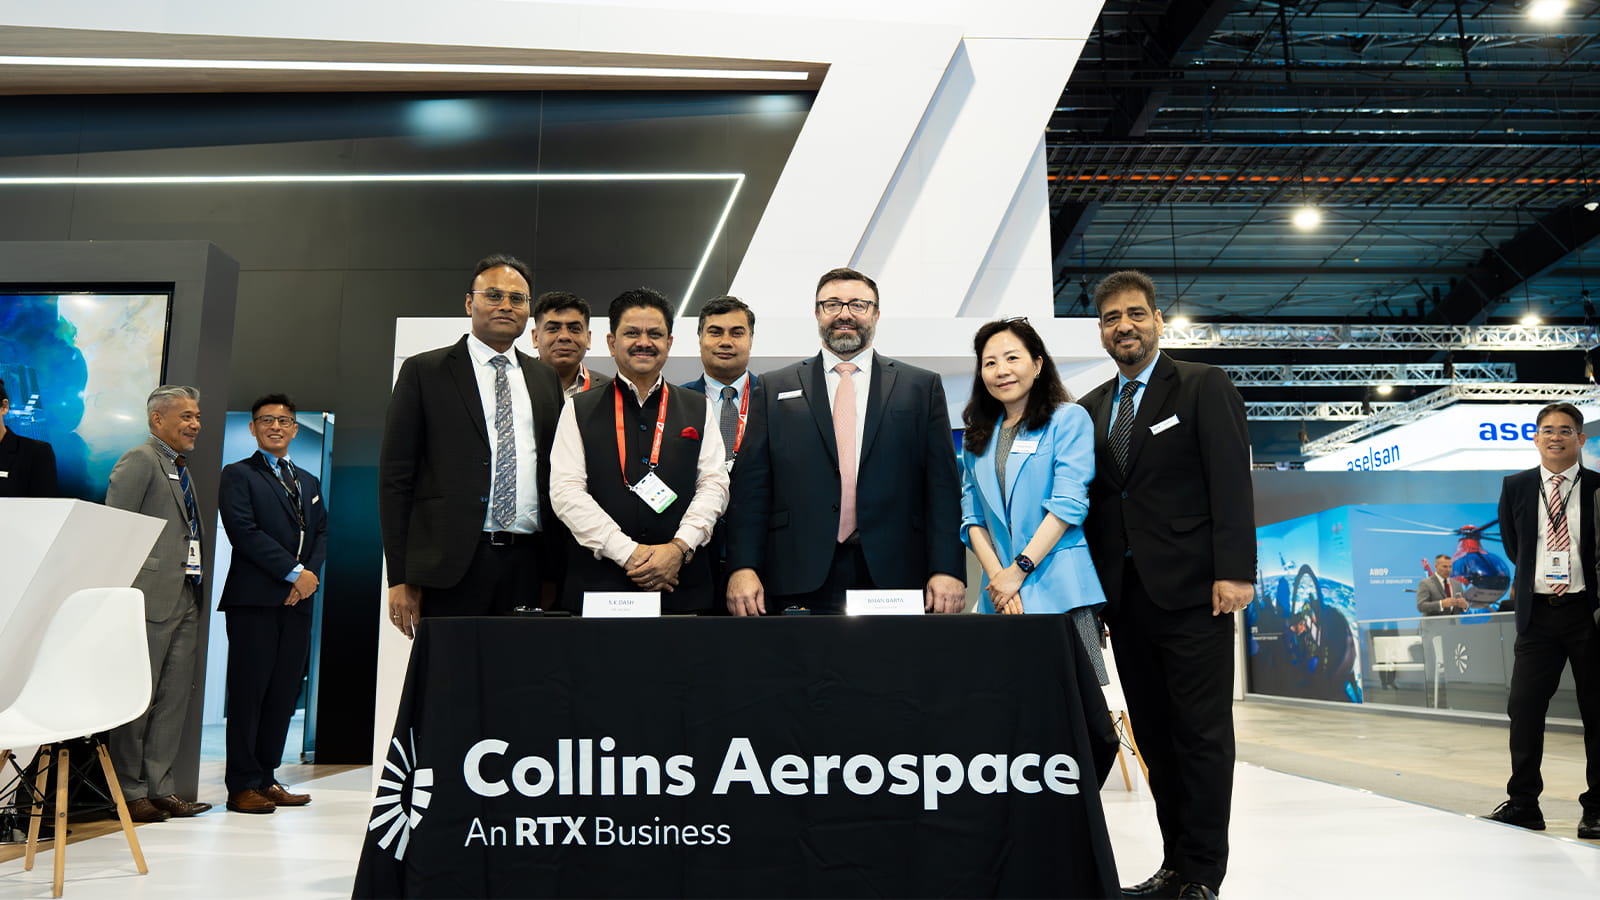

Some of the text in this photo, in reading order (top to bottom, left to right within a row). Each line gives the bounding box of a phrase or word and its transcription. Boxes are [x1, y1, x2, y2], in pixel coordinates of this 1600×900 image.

[463, 736, 1081, 811] Collins Aerospace
[464, 816, 731, 847] An RTX Business
